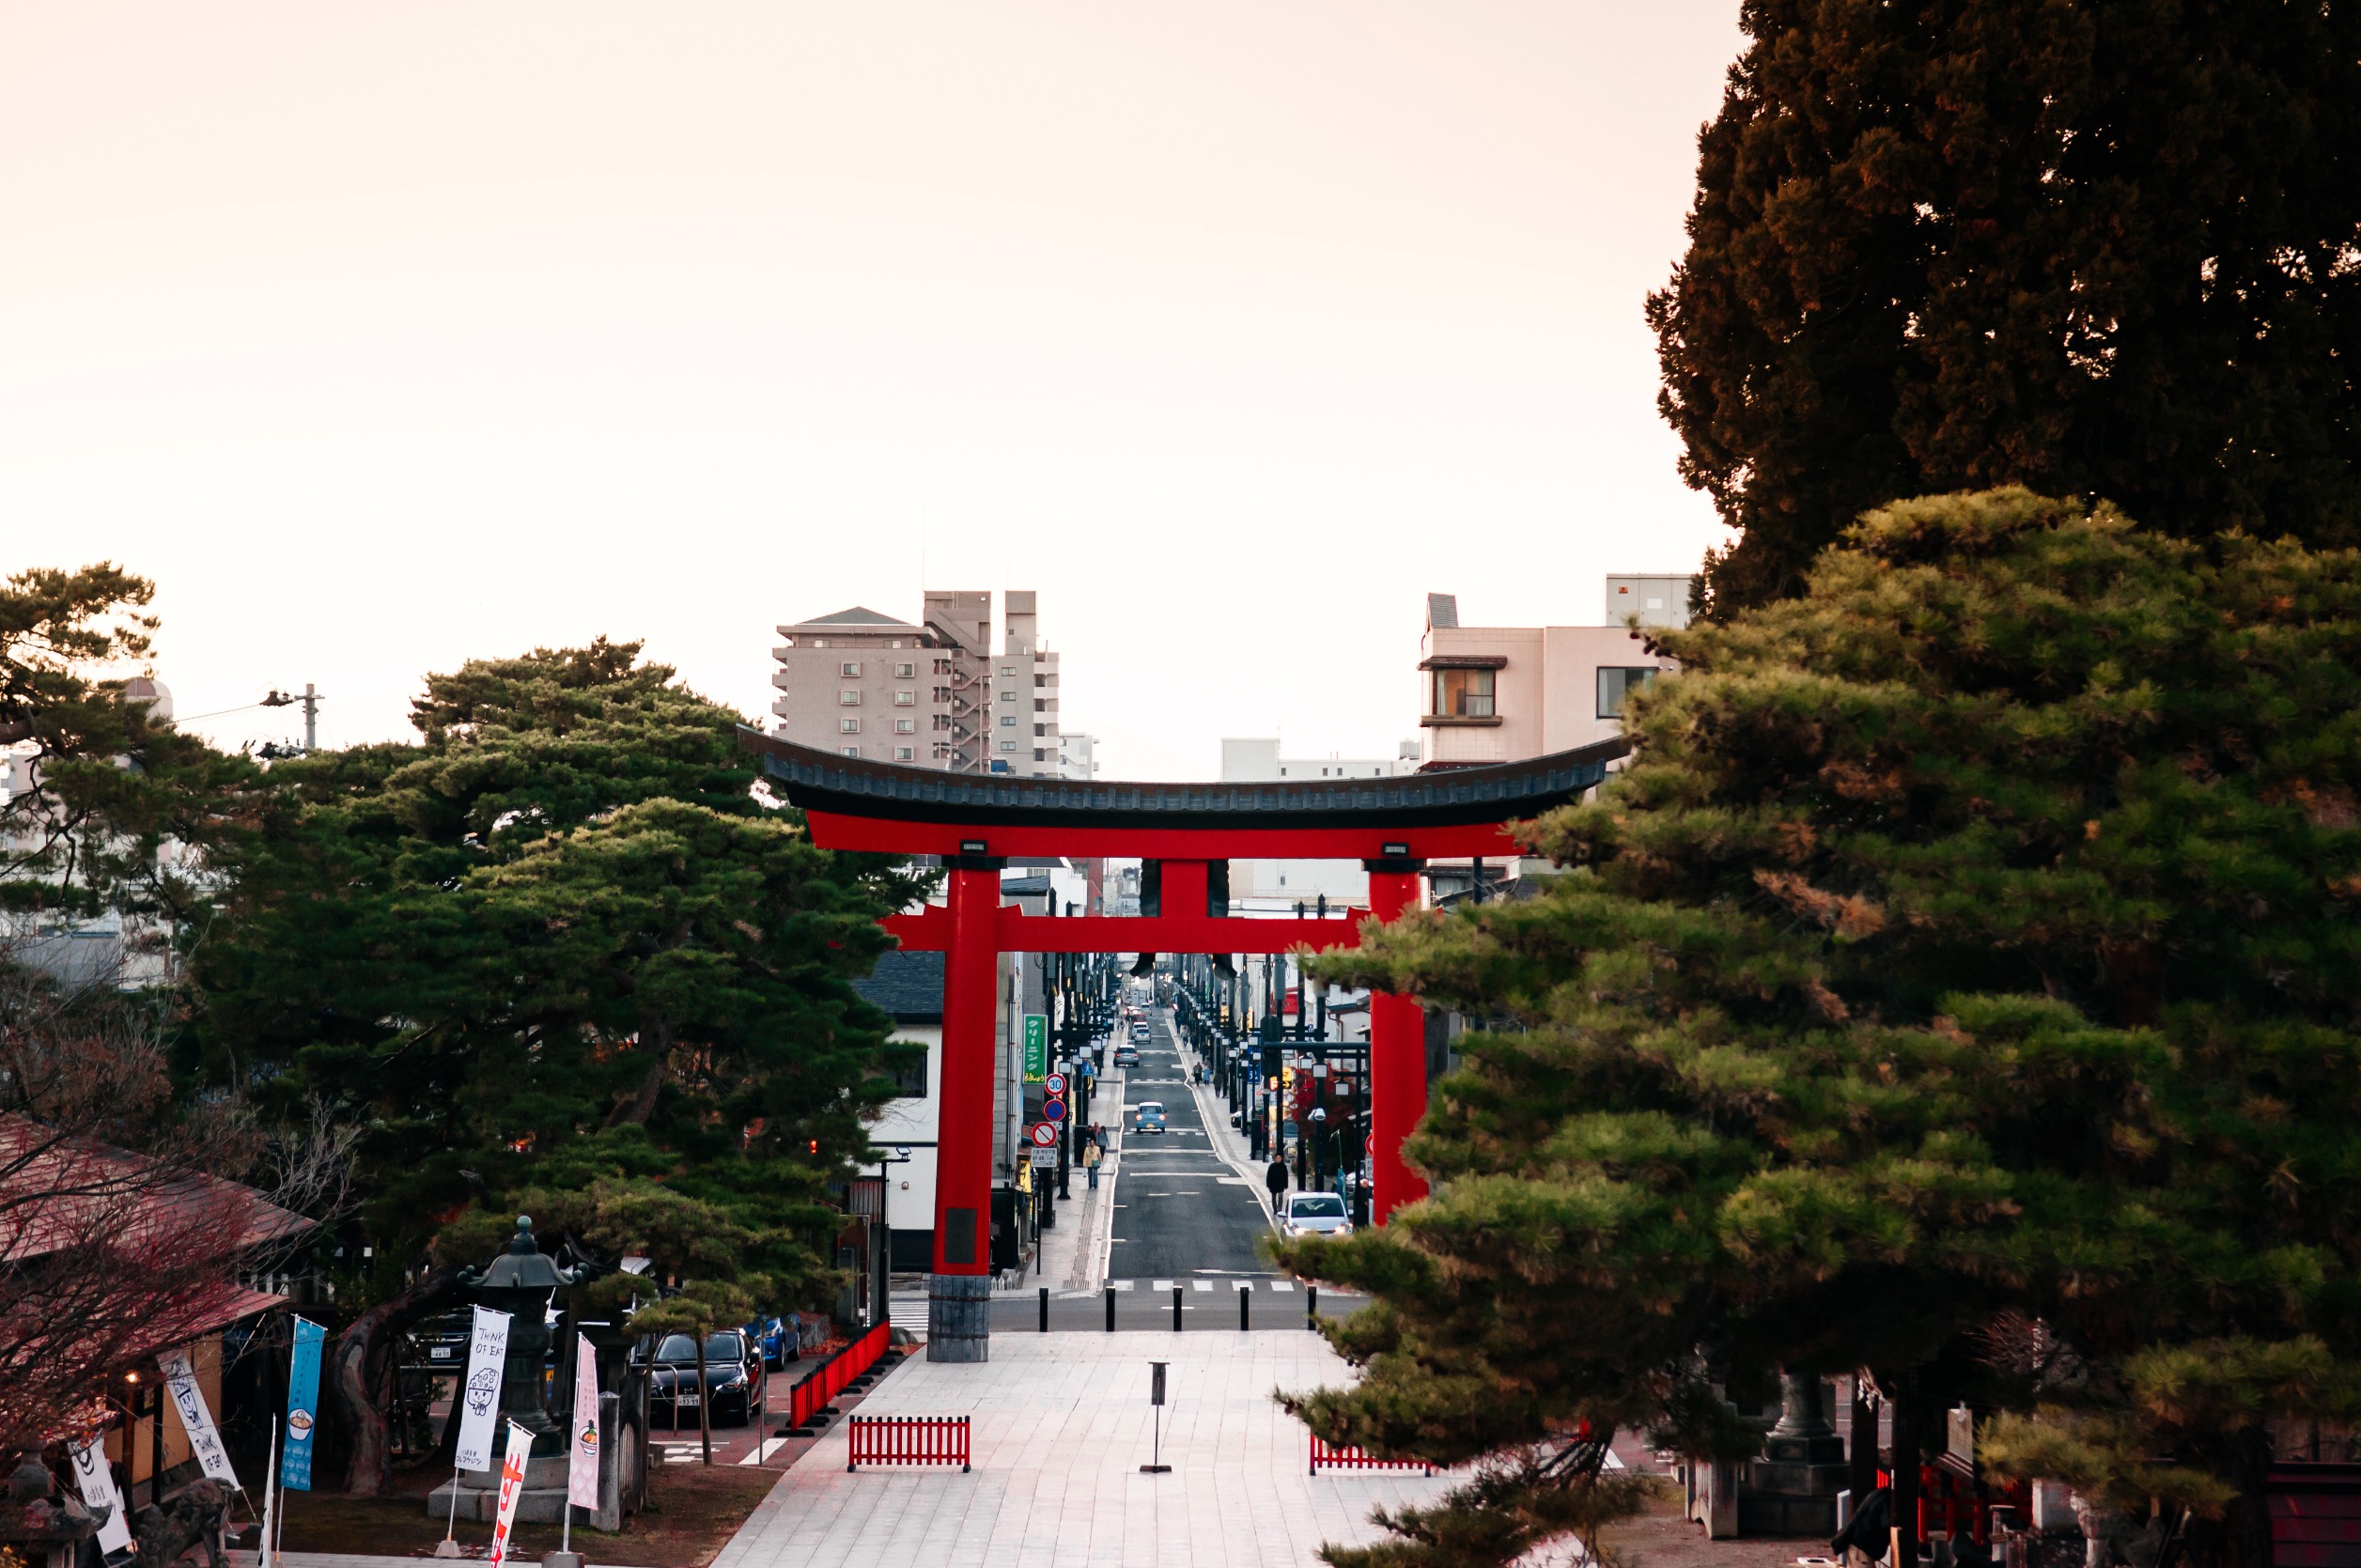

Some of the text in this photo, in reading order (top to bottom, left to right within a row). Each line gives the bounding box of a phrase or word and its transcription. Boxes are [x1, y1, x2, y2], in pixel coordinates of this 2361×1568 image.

[1027, 1019, 1039, 1071] クリーニング
[1049, 1079, 1062, 1090] 30
[478, 1327, 505, 1343] THINK
[476, 1343, 504, 1358] OF EAT
